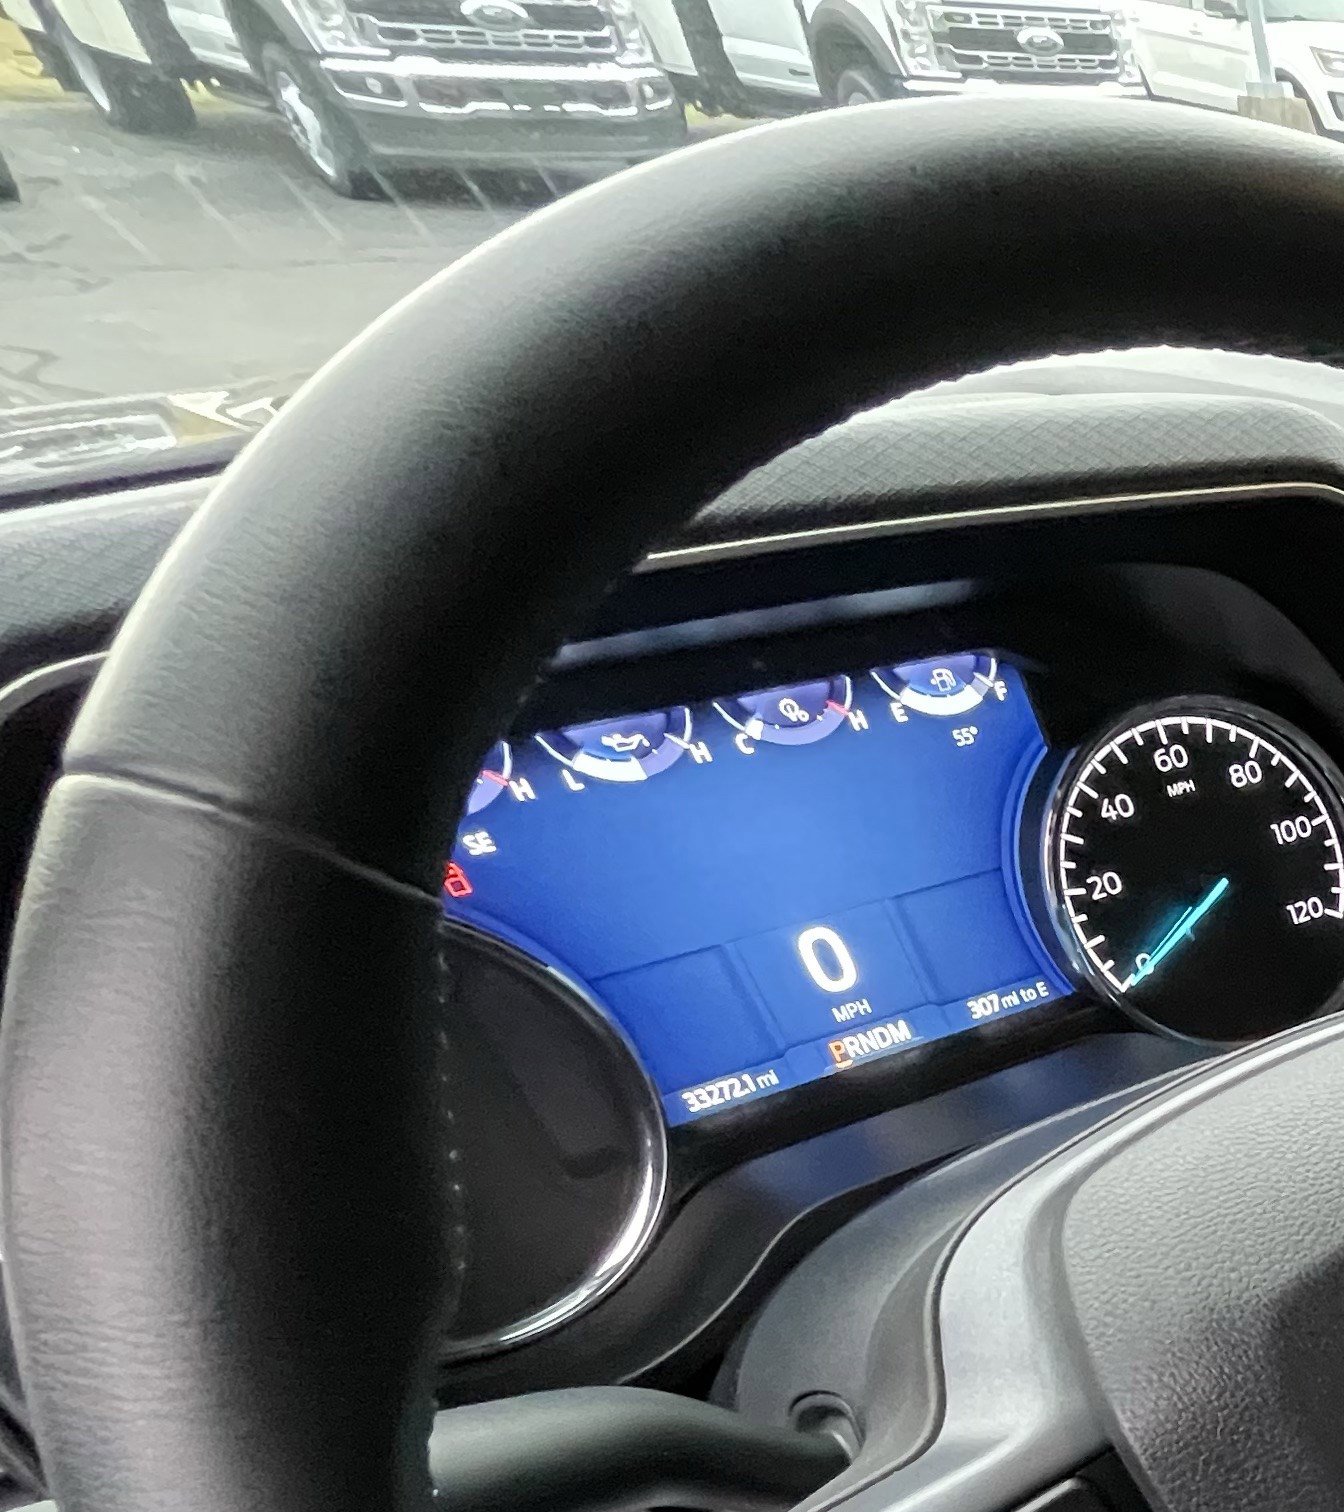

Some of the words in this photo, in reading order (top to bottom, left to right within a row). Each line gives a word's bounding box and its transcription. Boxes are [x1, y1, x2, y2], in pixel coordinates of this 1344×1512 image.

[993, 680, 1008, 701] F
[849, 709, 869, 731] H
[890, 702, 909, 723] E
[690, 741, 714, 764] H
[735, 733, 755, 755] C
[1153, 744, 1189, 773] 60
[563, 769, 586, 792] L
[1228, 760, 1263, 789] 80
[509, 777, 537, 802] H
[1166, 779, 1196, 798] MPH
[1100, 793, 1135, 821] 40
[1270, 815, 1312, 846] 100
[462, 831, 497, 856] SE
[1086, 871, 1123, 901] 20
[1285, 896, 1325, 925] 120
[799, 926, 858, 993] 0
[1135, 952, 1155, 976] 0
[832, 998, 872, 1024] MPH
[966, 994, 1001, 1020] 307
[1001, 987, 1020, 1010] mi
[1019, 984, 1037, 1003] to
[1036, 981, 1050, 999] E
[827, 1020, 913, 1064] PRNDM
